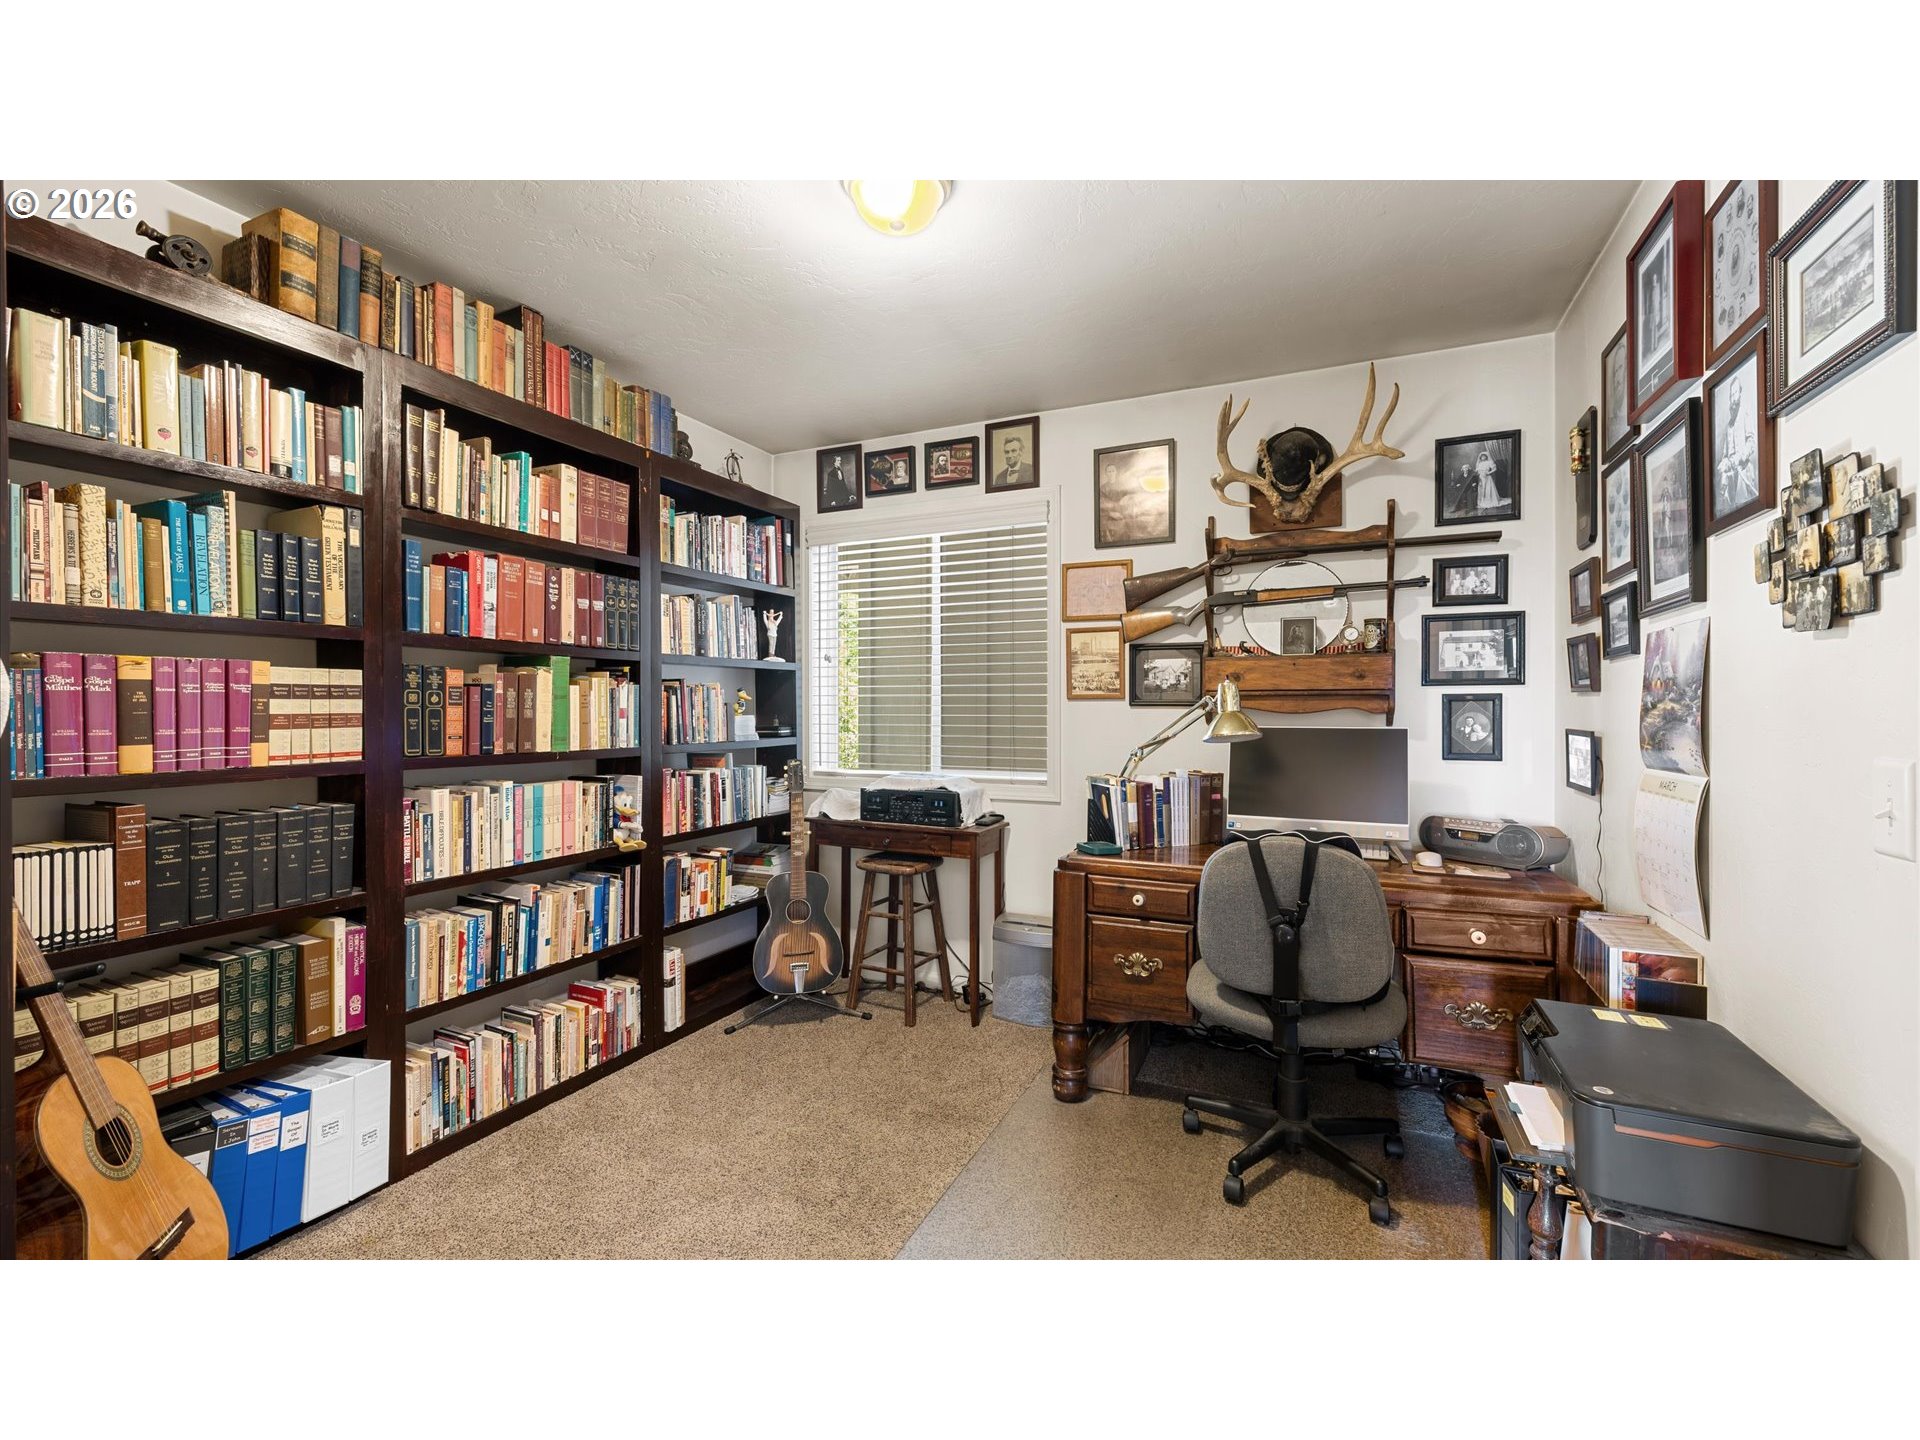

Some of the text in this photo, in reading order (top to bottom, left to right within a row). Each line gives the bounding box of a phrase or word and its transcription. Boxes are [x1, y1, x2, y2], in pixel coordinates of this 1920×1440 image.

[67, 529, 76, 554] HEBREWS
[175, 552, 185, 573] JAMES
[195, 534, 207, 597] REVELATION
[208, 535, 221, 597] REVELATION
[44, 676, 75, 685] Gospel
[84, 678, 112, 687] Gospel
[1659, 779, 1678, 792] MARCH
[427, 945, 436, 970] Theology
[222, 1123, 245, 1134] Sermons
[228, 1136, 241, 1144] John
[288, 1136, 300, 1144] John
